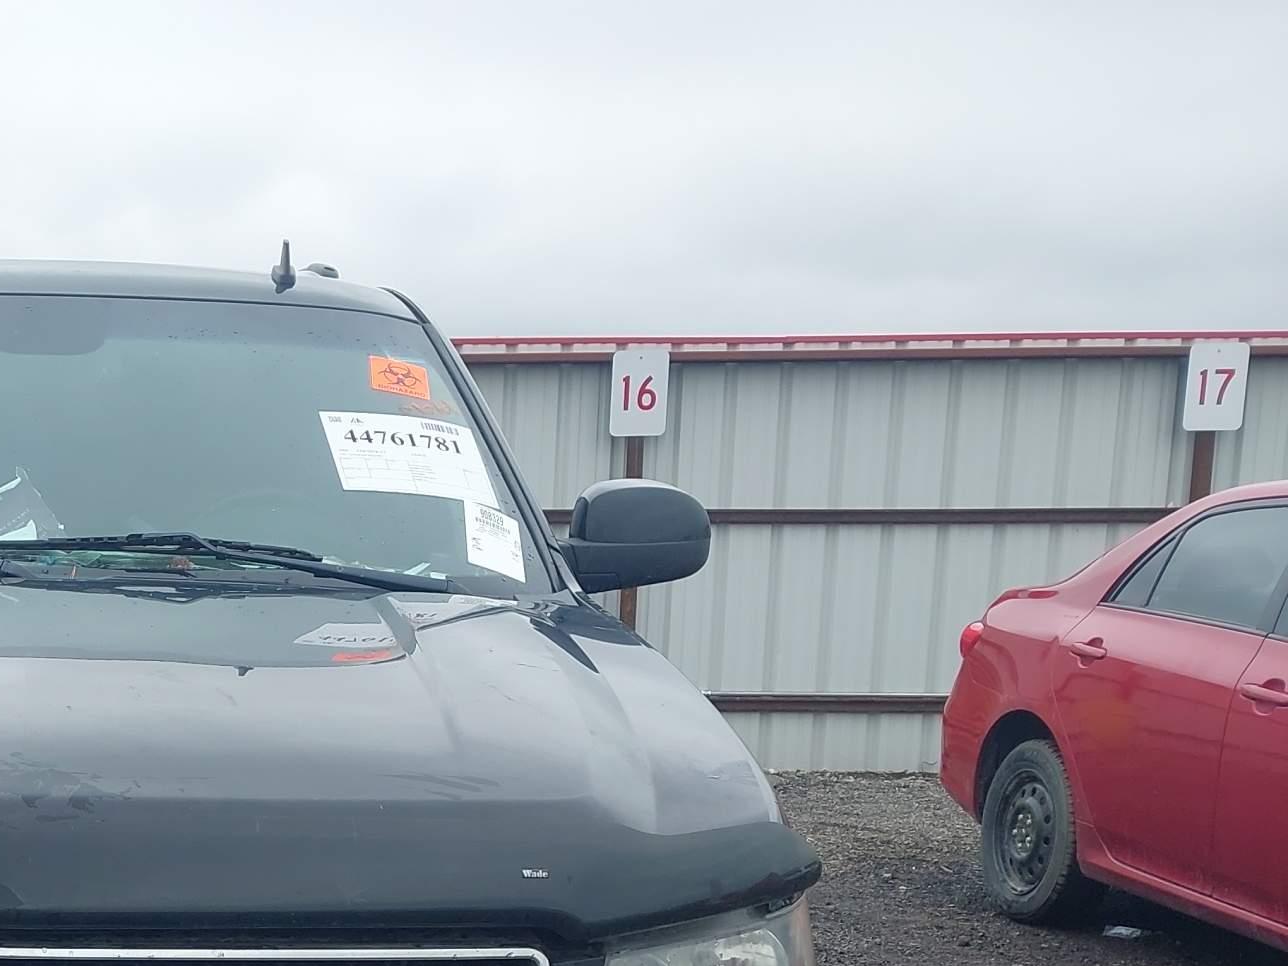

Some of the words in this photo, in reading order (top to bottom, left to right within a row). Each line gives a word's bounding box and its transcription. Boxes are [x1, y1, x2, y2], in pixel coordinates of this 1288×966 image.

[622, 375, 657, 411] 16
[1199, 368, 1236, 405] 17
[344, 429, 462, 455] 44761781
[522, 869, 549, 878] Wade
